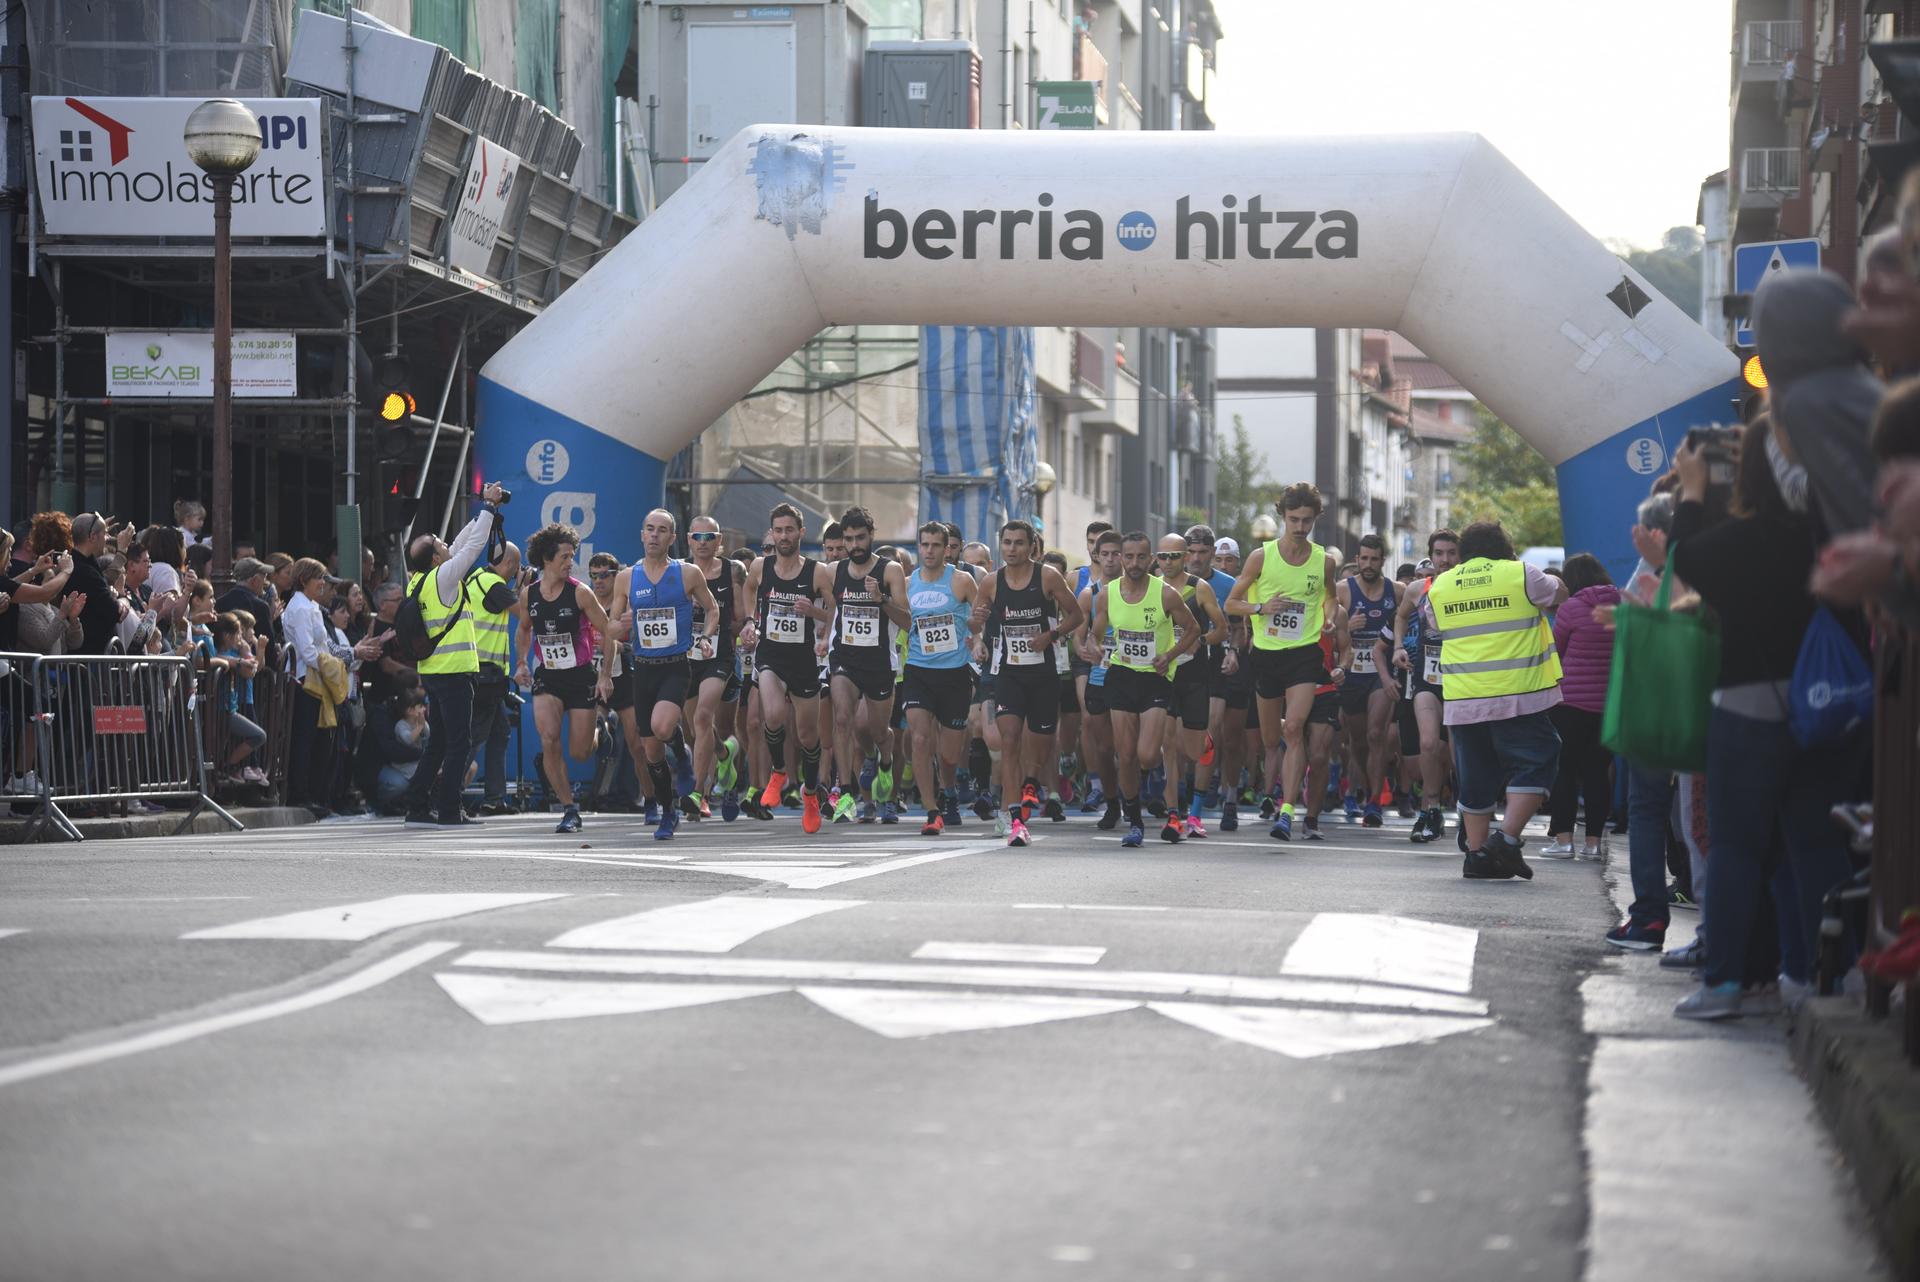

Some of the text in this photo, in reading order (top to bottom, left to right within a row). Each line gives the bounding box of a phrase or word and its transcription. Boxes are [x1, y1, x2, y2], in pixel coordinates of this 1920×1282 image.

[863, 191, 1359, 260] berria info hitza
[112, 366, 200, 380] BEKABI
[538, 441, 556, 482] info
[1636, 439, 1651, 473] info
[1444, 597, 1510, 615] ANTOLAKUNTZA
[773, 619, 798, 632] 768
[847, 620, 872, 635] 765
[1272, 614, 1298, 629] 656
[643, 623, 669, 637] 665
[925, 628, 950, 644] 823
[546, 646, 568, 660] 513
[1123, 644, 1149, 657] 658
